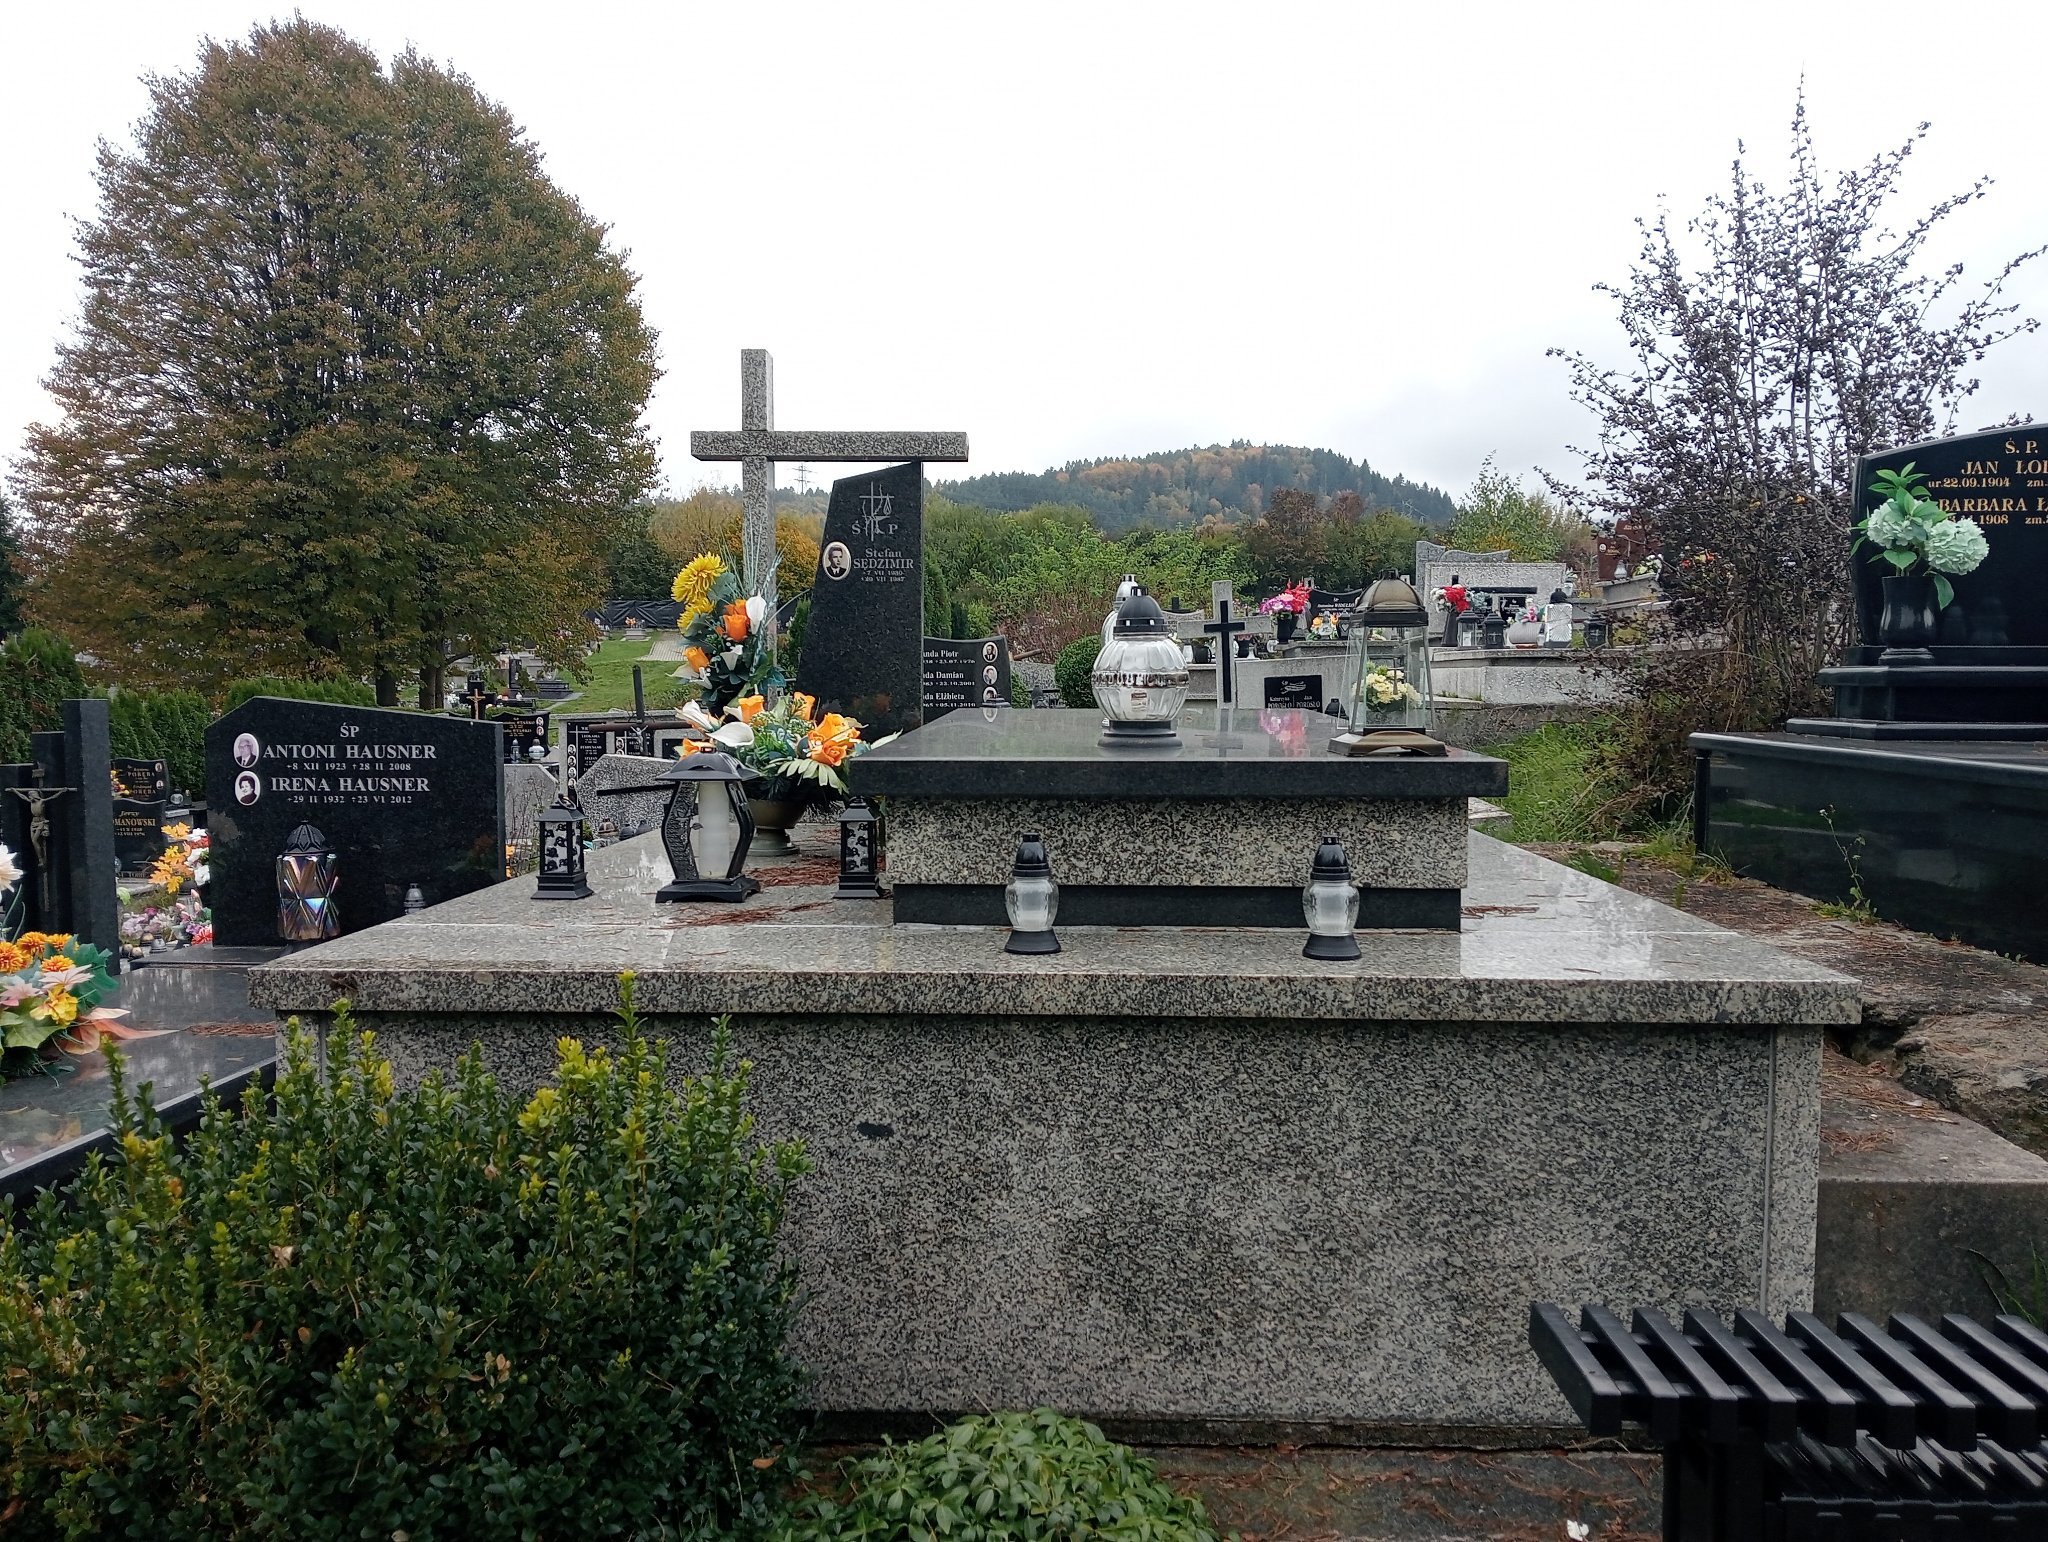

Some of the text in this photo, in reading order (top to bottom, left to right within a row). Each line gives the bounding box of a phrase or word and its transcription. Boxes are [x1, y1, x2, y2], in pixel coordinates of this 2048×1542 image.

[1961, 460, 1999, 475] JAN
[1939, 497, 2028, 512] BARBARA
[865, 547, 903, 558] Stefan
[853, 558, 914, 570] SĘDZIMIR
[936, 671, 964, 679] Damian
[339, 722, 360, 738] ŚP
[262, 744, 437, 759] ANTONI HAUSNER
[325, 762, 346, 771] 1923
[389, 762, 412, 771] 2008
[270, 777, 431, 792] IRENA HAUSNER
[323, 795, 345, 804] 1932
[390, 795, 413, 804] 2012
[113, 818, 156, 827] MANOWSKI
